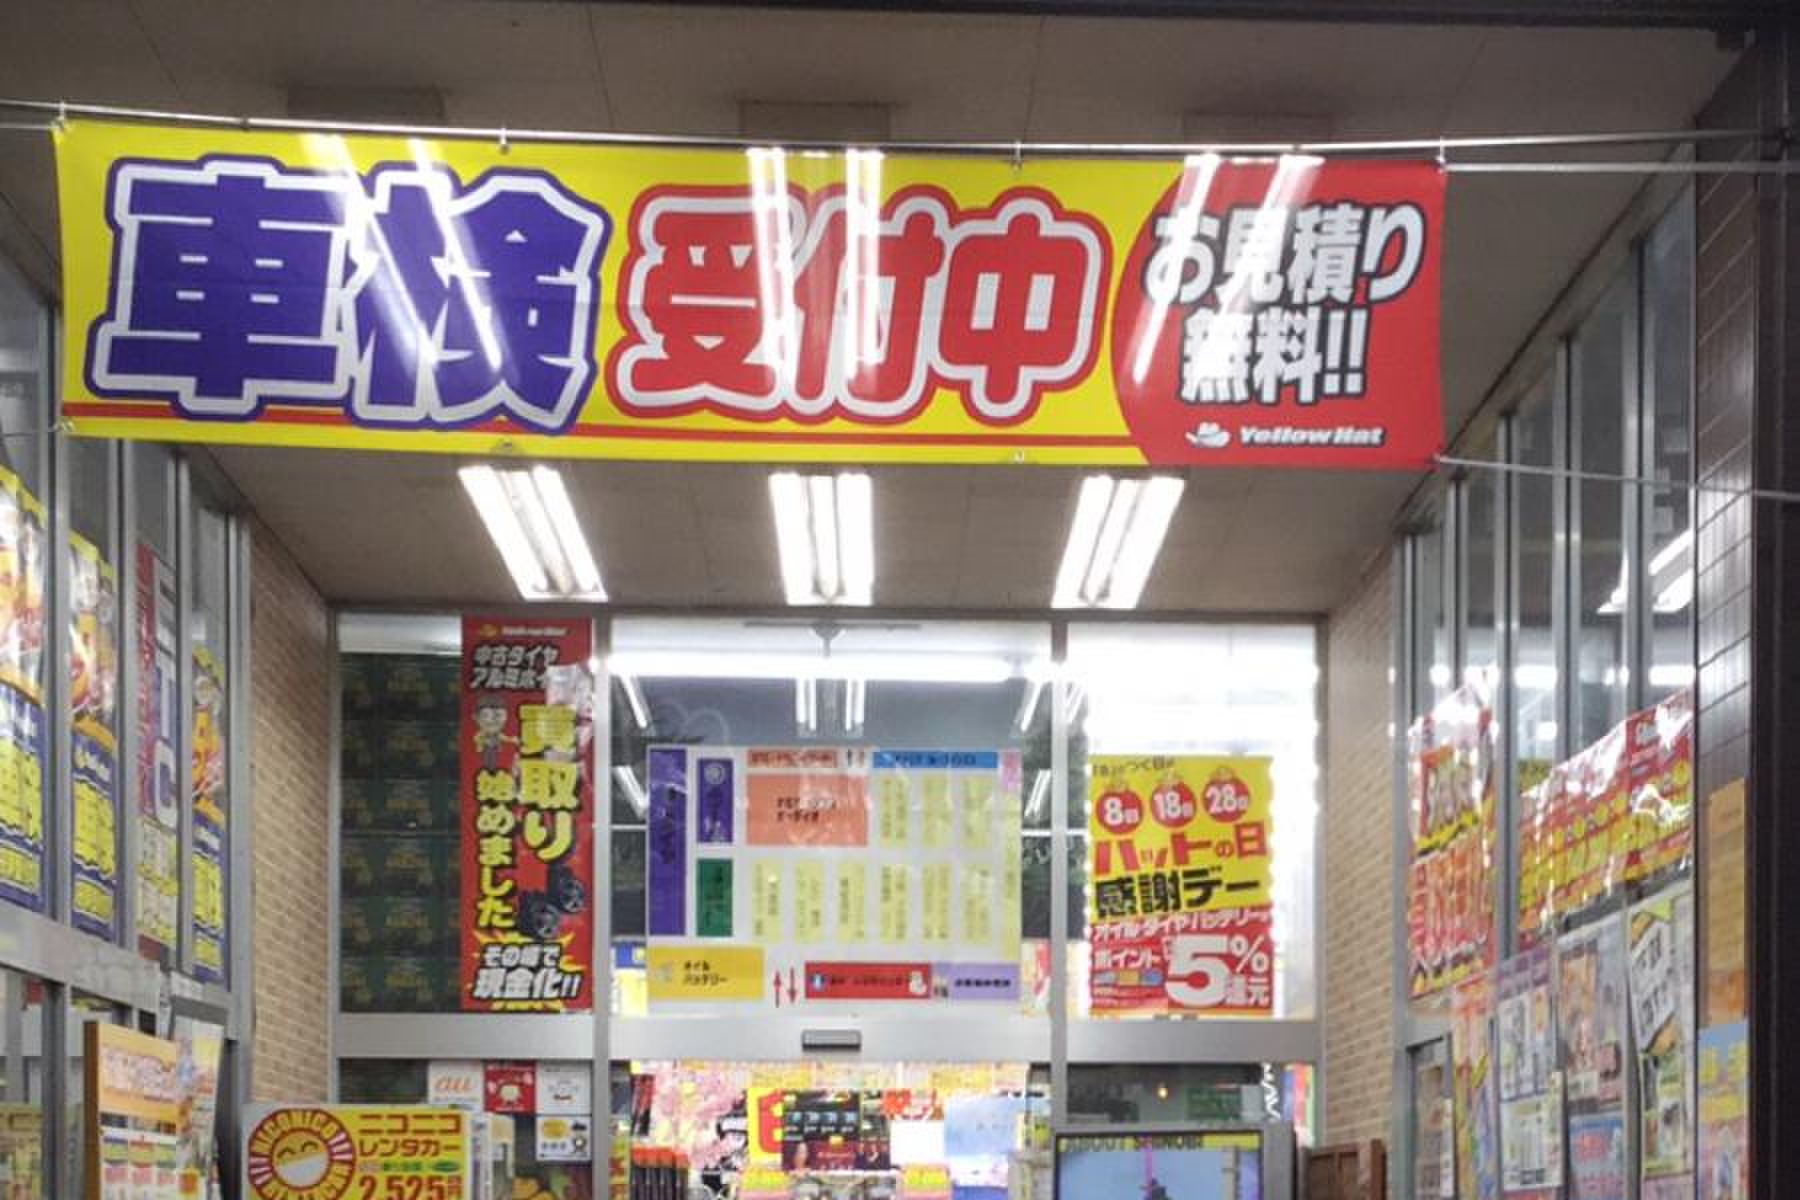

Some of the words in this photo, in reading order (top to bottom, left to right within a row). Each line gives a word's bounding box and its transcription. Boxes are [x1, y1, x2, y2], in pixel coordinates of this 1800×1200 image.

[1144, 202, 1424, 303] お見積り
[88, 158, 610, 432] 車検
[605, 184, 1110, 425] 受付中
[1180, 305, 1370, 404] 無料!!
[475, 769, 514, 928] 始めました
[1094, 822, 1268, 876] ハットの日
[1095, 866, 1261, 919] 感謝デー
[358, 1114, 461, 1135] ニコニコ
[359, 1138, 461, 1158] レンタカー
